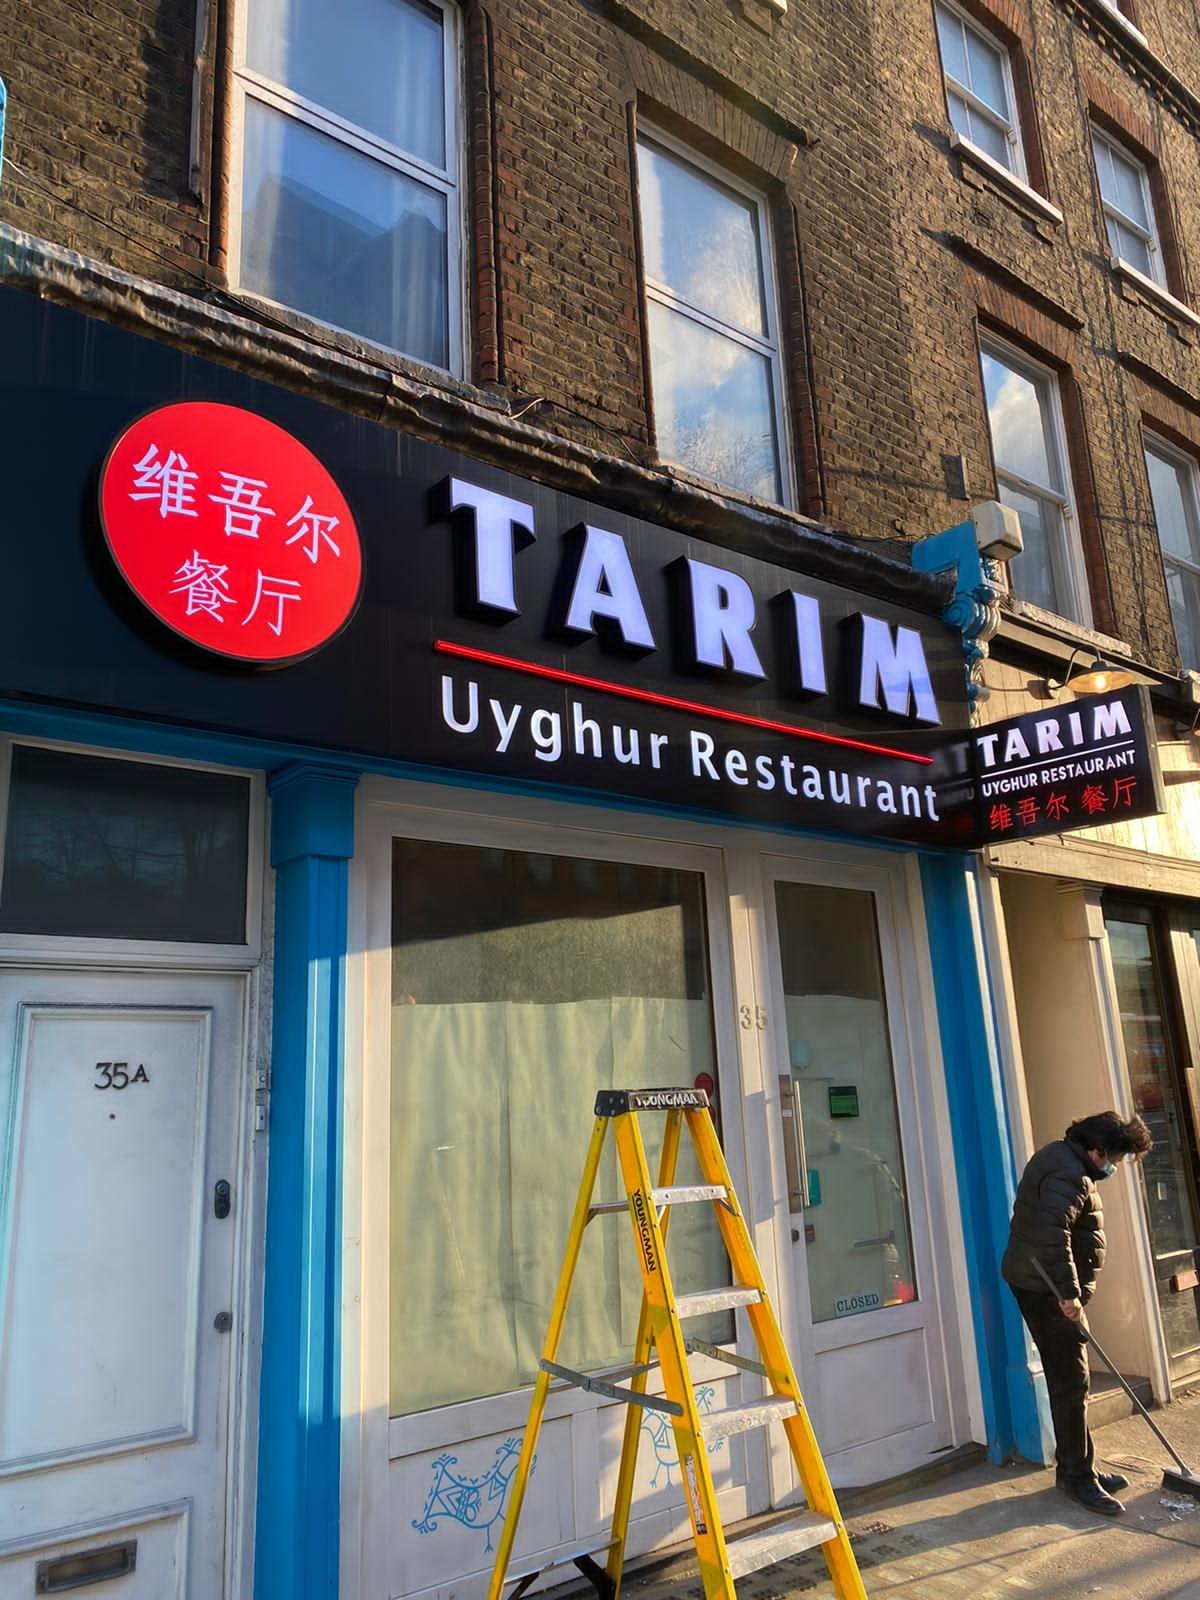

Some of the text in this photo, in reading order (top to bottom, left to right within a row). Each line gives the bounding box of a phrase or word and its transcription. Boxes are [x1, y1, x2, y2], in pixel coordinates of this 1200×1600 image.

[128, 443, 341, 564] 维吾尔
[169, 549, 302, 637] 餐厅
[449, 476, 942, 725] TARIM
[441, 675, 669, 762] Uyghur
[690, 730, 939, 822] Restaurant
[976, 700, 1132, 768] TARIM
[982, 750, 1136, 797] UYGHUR RESTAURANT
[740, 1005, 768, 1030] 35
[94, 1062, 150, 1090] 35A
[632, 1189, 657, 1272] YOUNGMAN
[836, 1293, 880, 1313] CLOSED
